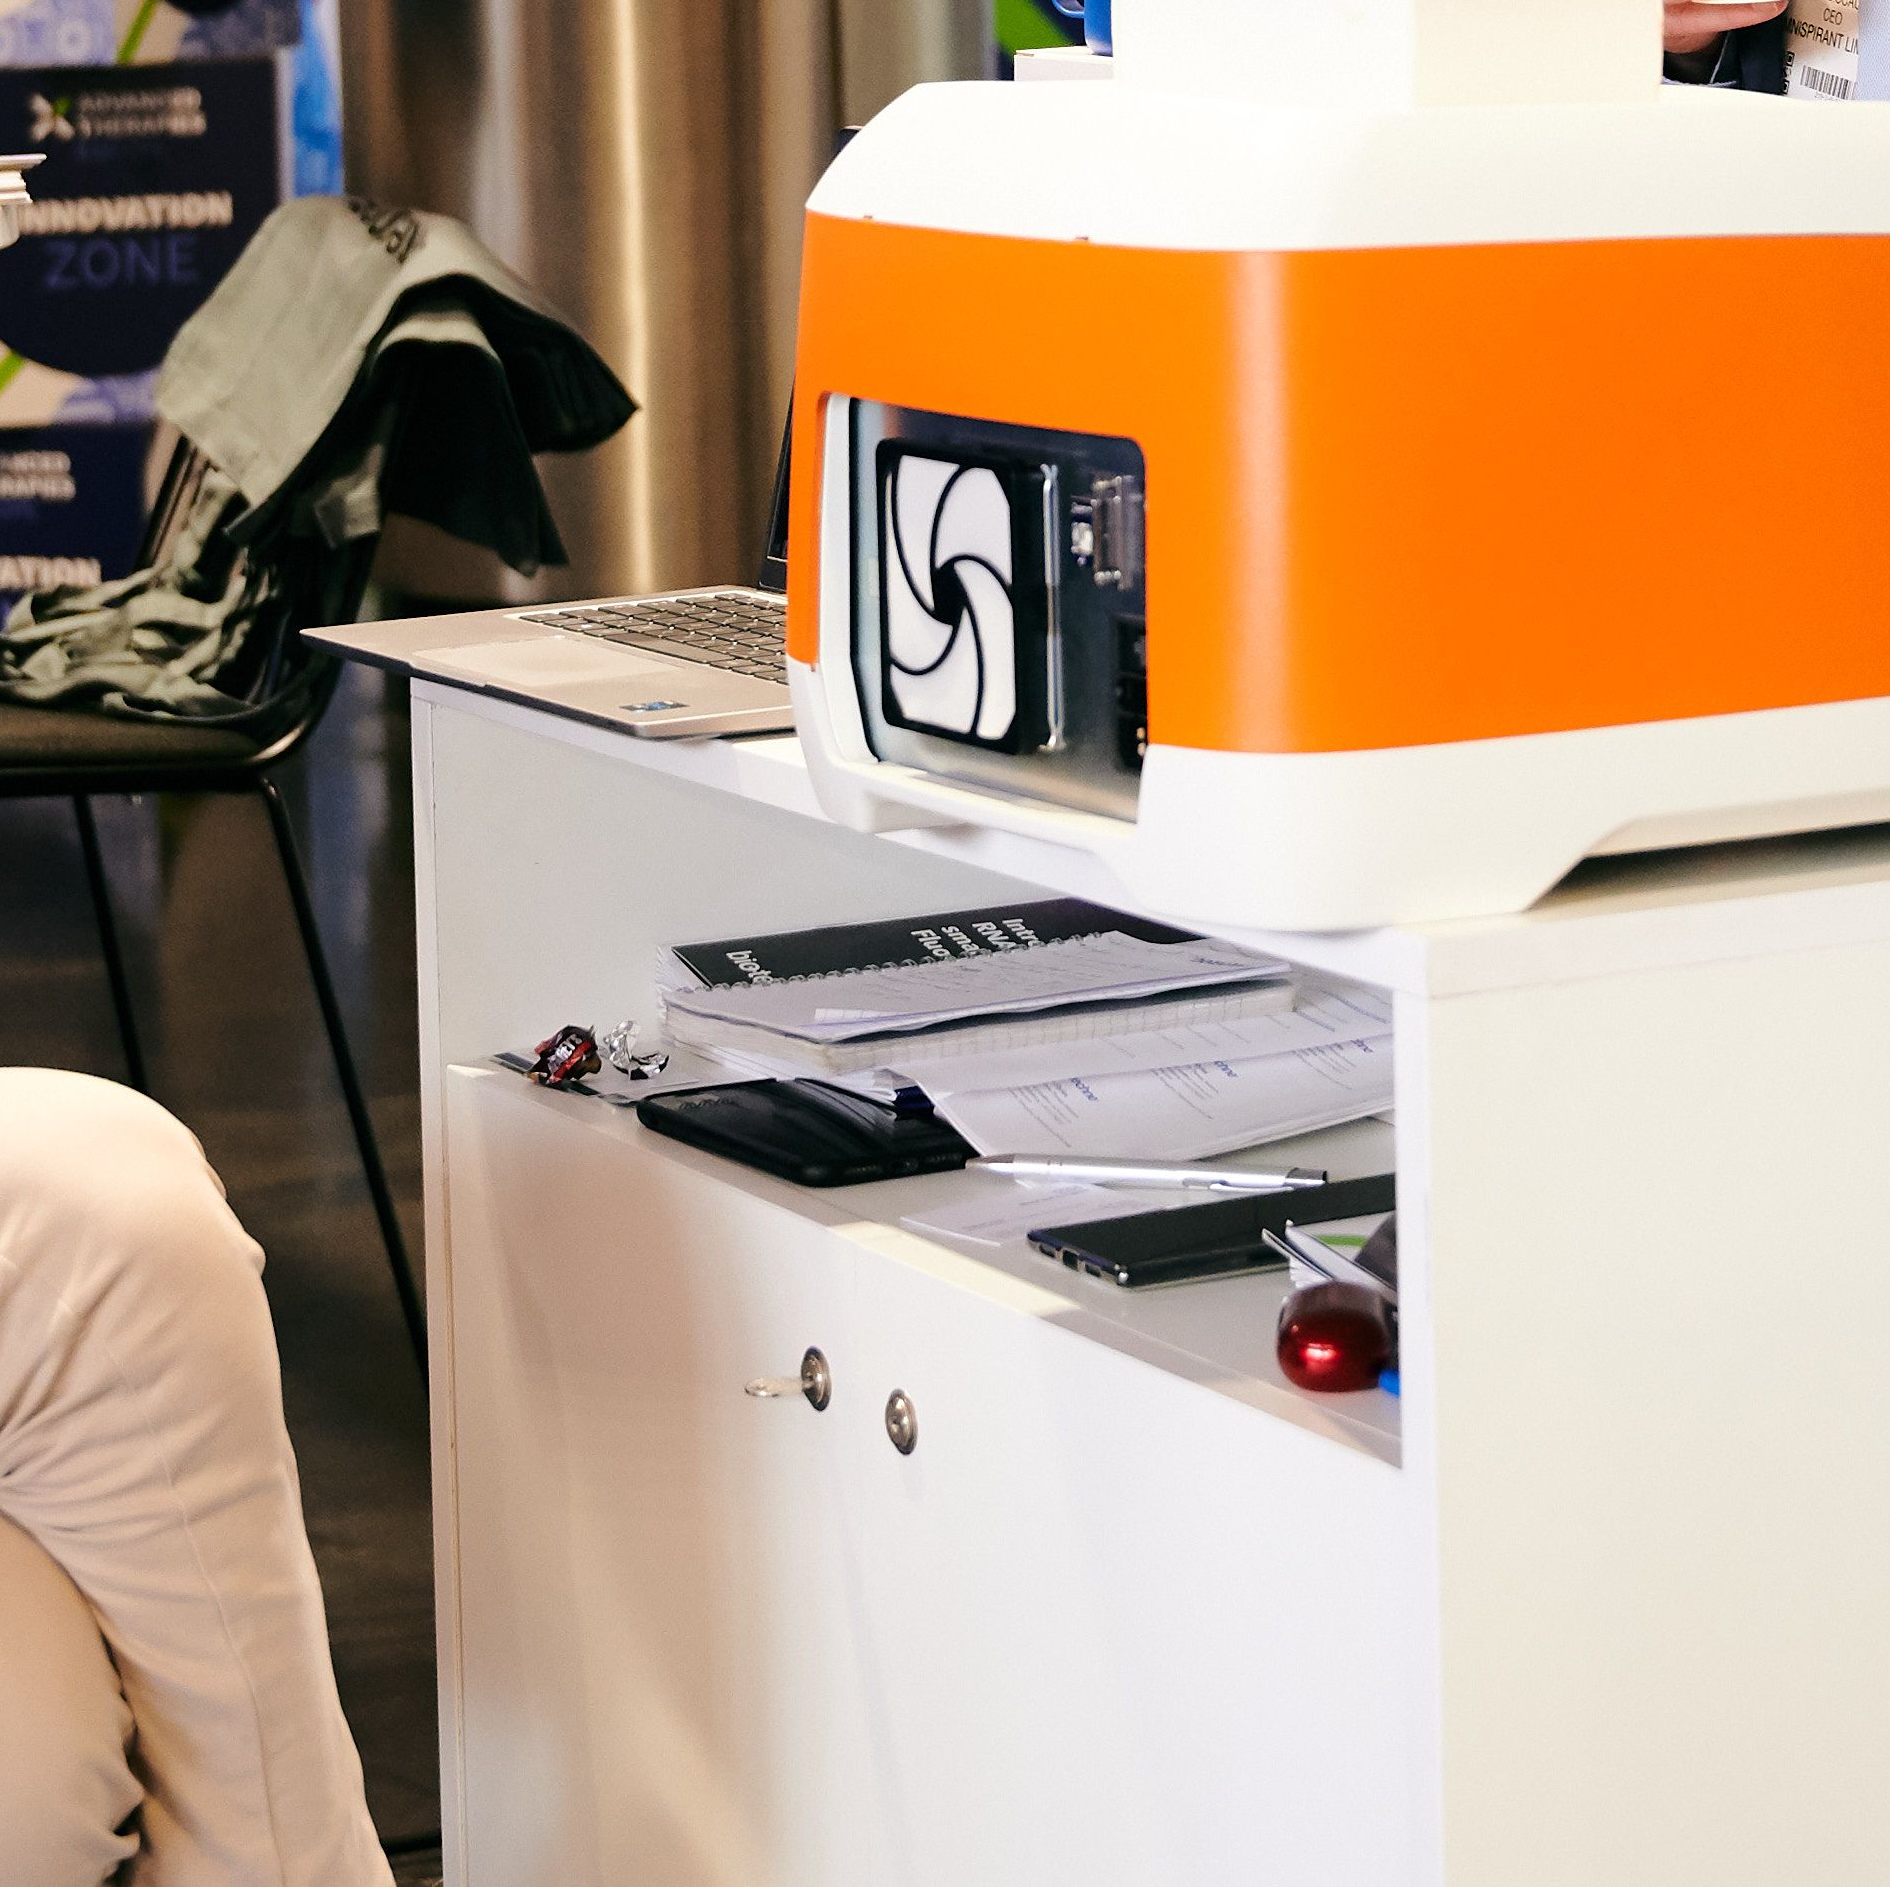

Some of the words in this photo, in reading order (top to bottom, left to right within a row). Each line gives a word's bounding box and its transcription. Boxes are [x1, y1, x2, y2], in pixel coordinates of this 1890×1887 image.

[1822, 7, 1844, 26] CEO
[18, 190, 233, 237] NNOVATION
[44, 234, 200, 289] ZONE
[910, 928, 951, 958] Fluo
[940, 925, 981, 956] sma
